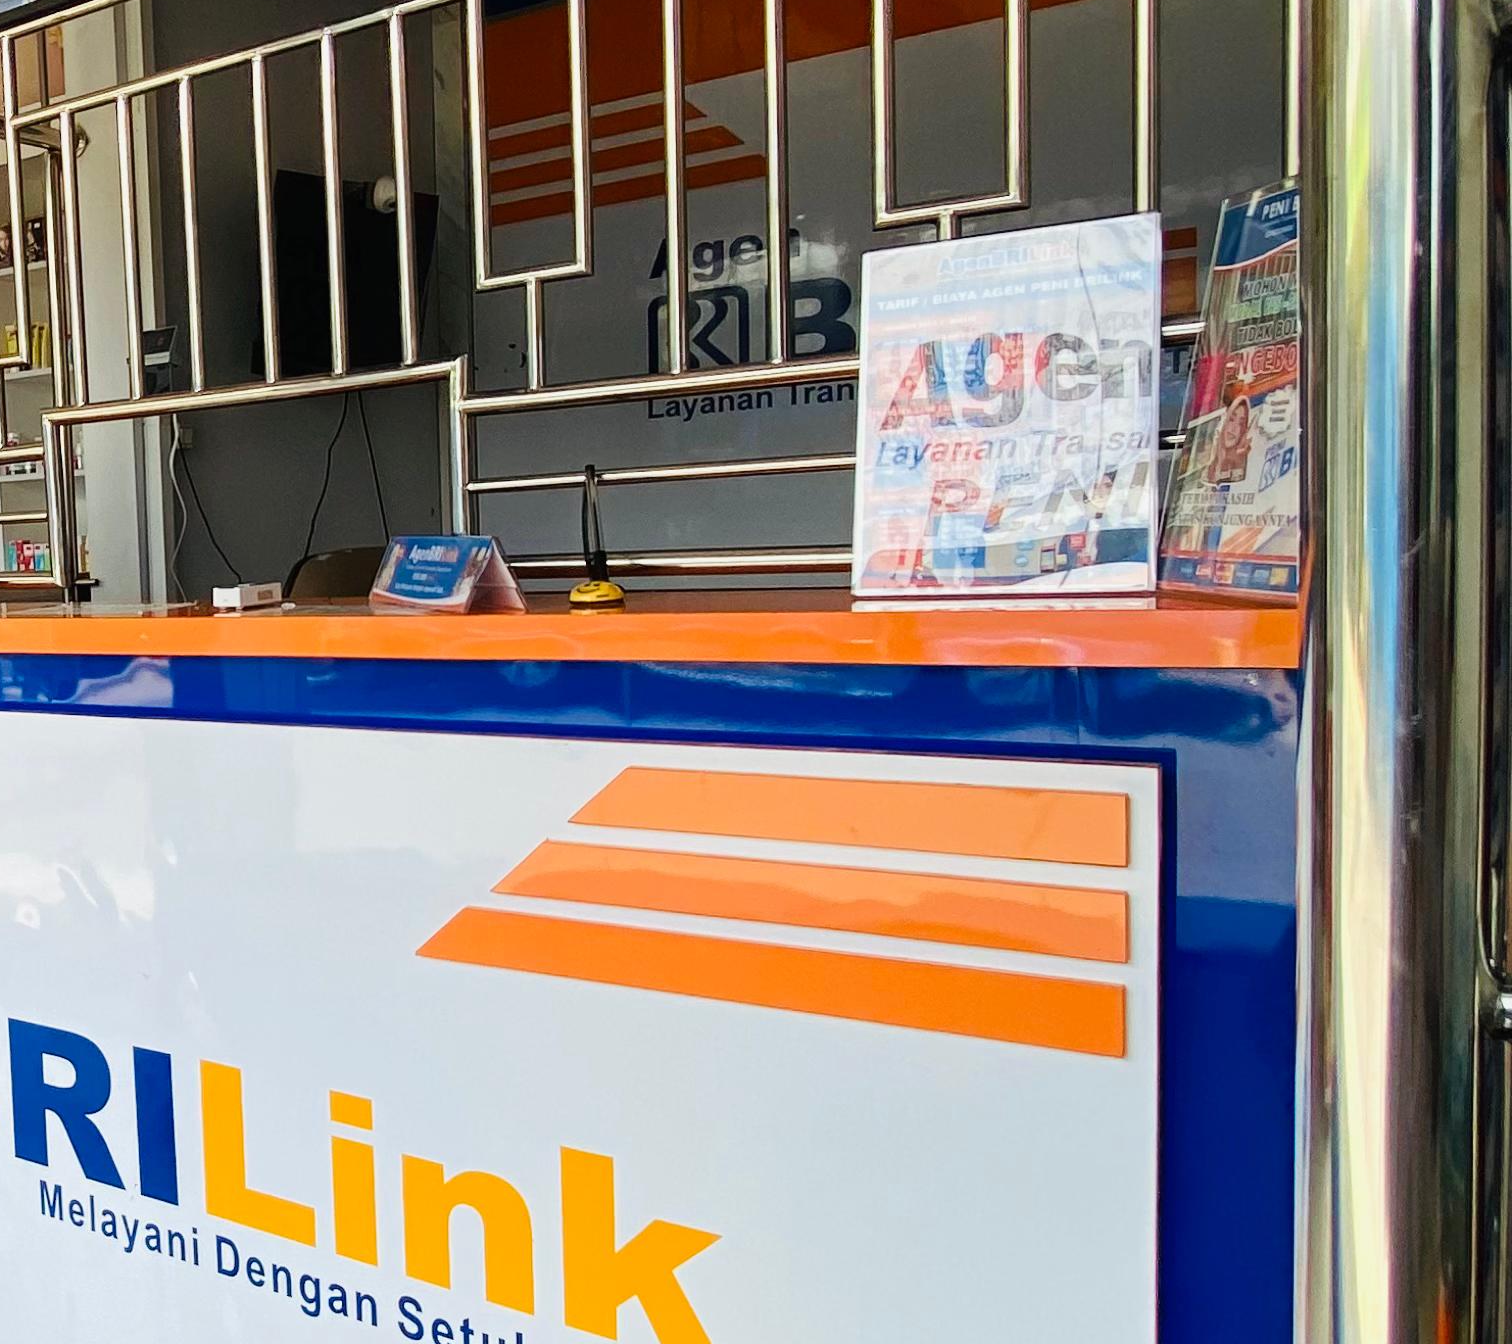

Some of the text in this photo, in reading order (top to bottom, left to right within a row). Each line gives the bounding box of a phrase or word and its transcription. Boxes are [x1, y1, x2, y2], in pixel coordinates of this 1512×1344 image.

[877, 296, 920, 311] TARIF
[933, 291, 977, 306] BIAYA
[982, 284, 1025, 299] AGEN
[1031, 279, 1069, 293] PENI
[879, 332, 1152, 432] Agen
[648, 392, 773, 421] Layanan
[876, 432, 1016, 472] Layanan
[39, 1180, 202, 1268] Melayani
[216, 1235, 379, 1328] Dengan
